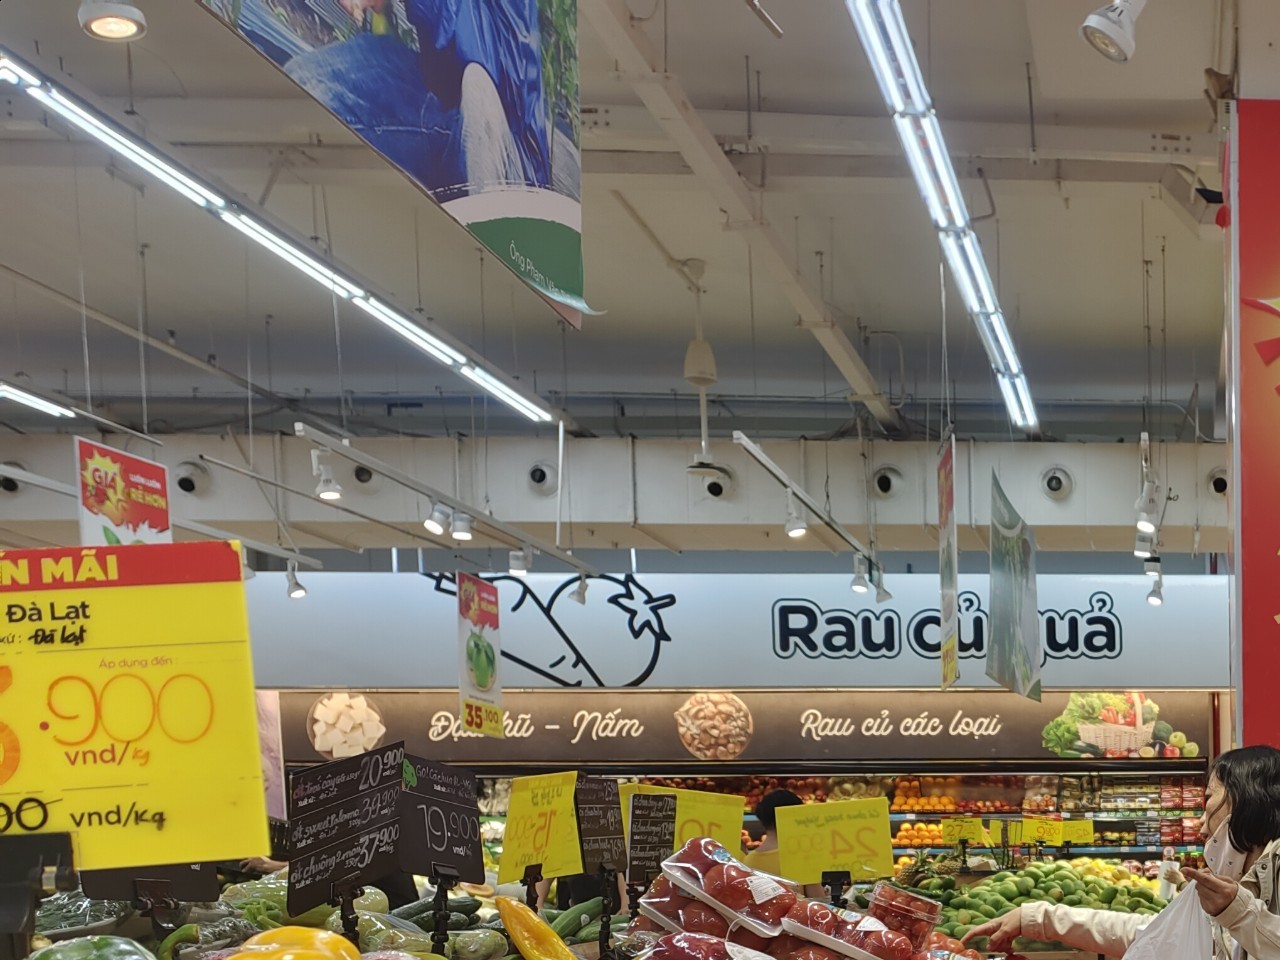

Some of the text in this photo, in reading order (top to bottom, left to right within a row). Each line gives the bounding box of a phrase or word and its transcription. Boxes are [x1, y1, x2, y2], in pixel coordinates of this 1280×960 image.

[0, 555, 29, 586] N
[5, 601, 90, 625] Đà Lạt
[774, 591, 1121, 662] Rau củ uả
[99, 654, 173, 669] Áp dụng đến
[571, 708, 644, 743] Nấm
[800, 708, 1002, 741] Rau củ các loại
[417, 804, 480, 852] 19.900
